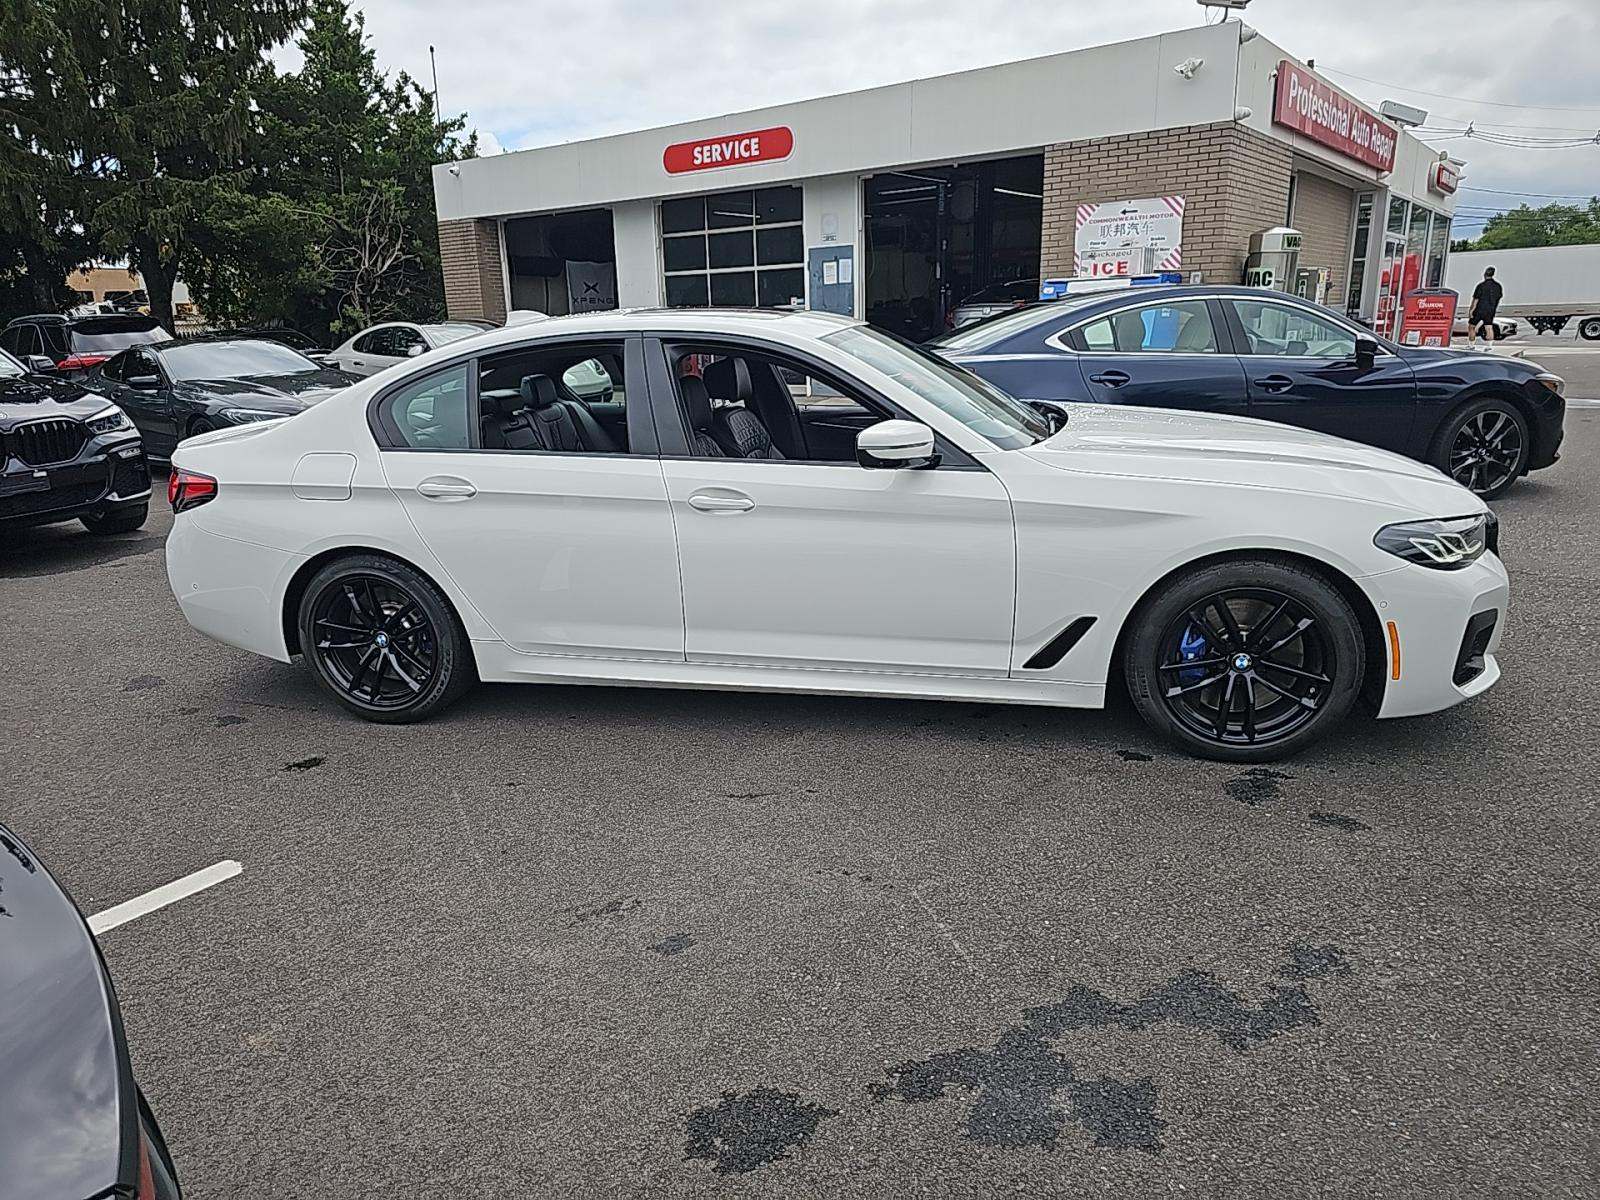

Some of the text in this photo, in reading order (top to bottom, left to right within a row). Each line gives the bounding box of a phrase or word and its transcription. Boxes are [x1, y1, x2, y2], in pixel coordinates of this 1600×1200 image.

[1288, 71, 1394, 165] Professional Auto Repair
[693, 137, 760, 165] SERVICE
[1089, 212, 1174, 225] COMMONWEALTH MOTOR
[1286, 236, 1302, 248] VAC
[1092, 261, 1128, 276] ICE
[1247, 270, 1273, 287] VAC
[572, 296, 615, 305] XPENG
